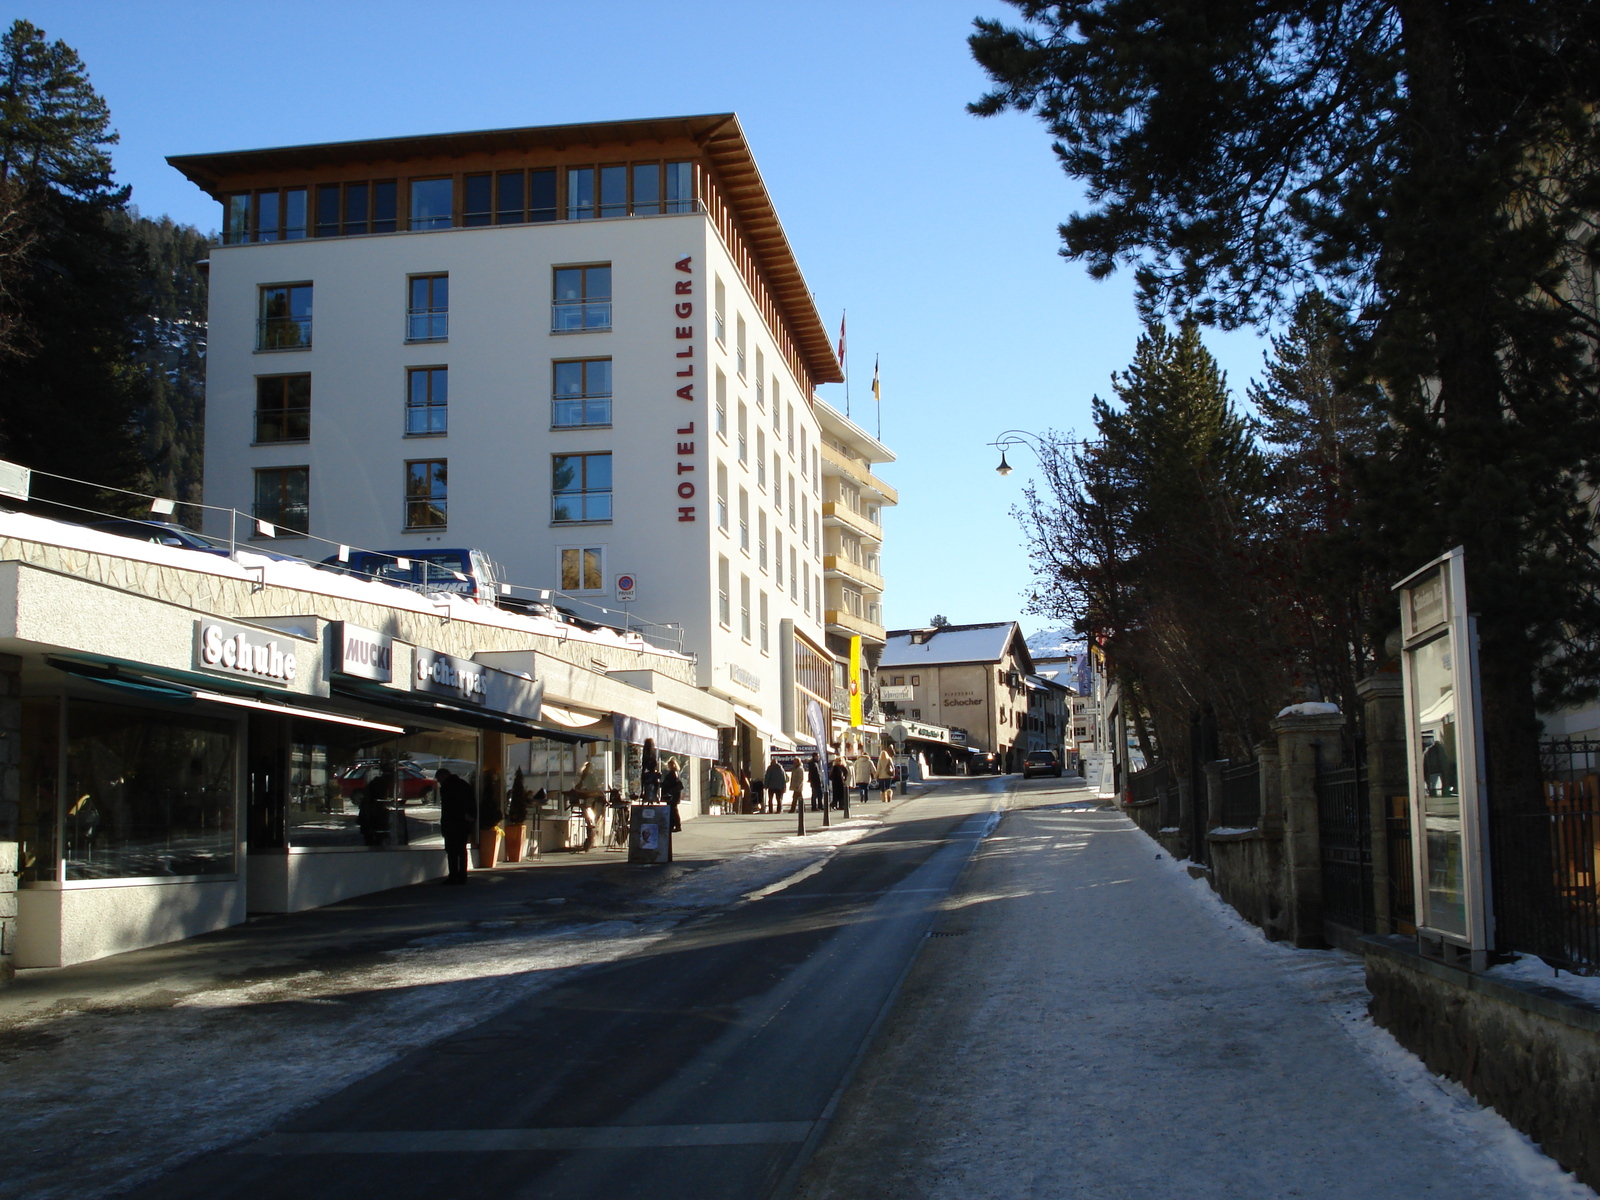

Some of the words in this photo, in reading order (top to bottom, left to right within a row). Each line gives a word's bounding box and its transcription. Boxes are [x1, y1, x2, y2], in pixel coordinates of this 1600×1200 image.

[675, 256, 693, 401] ALLEGRA
[677, 421, 695, 522] HOTEL
[202, 624, 296, 680] Schuhe
[345, 637, 390, 671] MUCKI
[417, 657, 486, 697] s-charpas
[943, 698, 983, 707] Schocher
